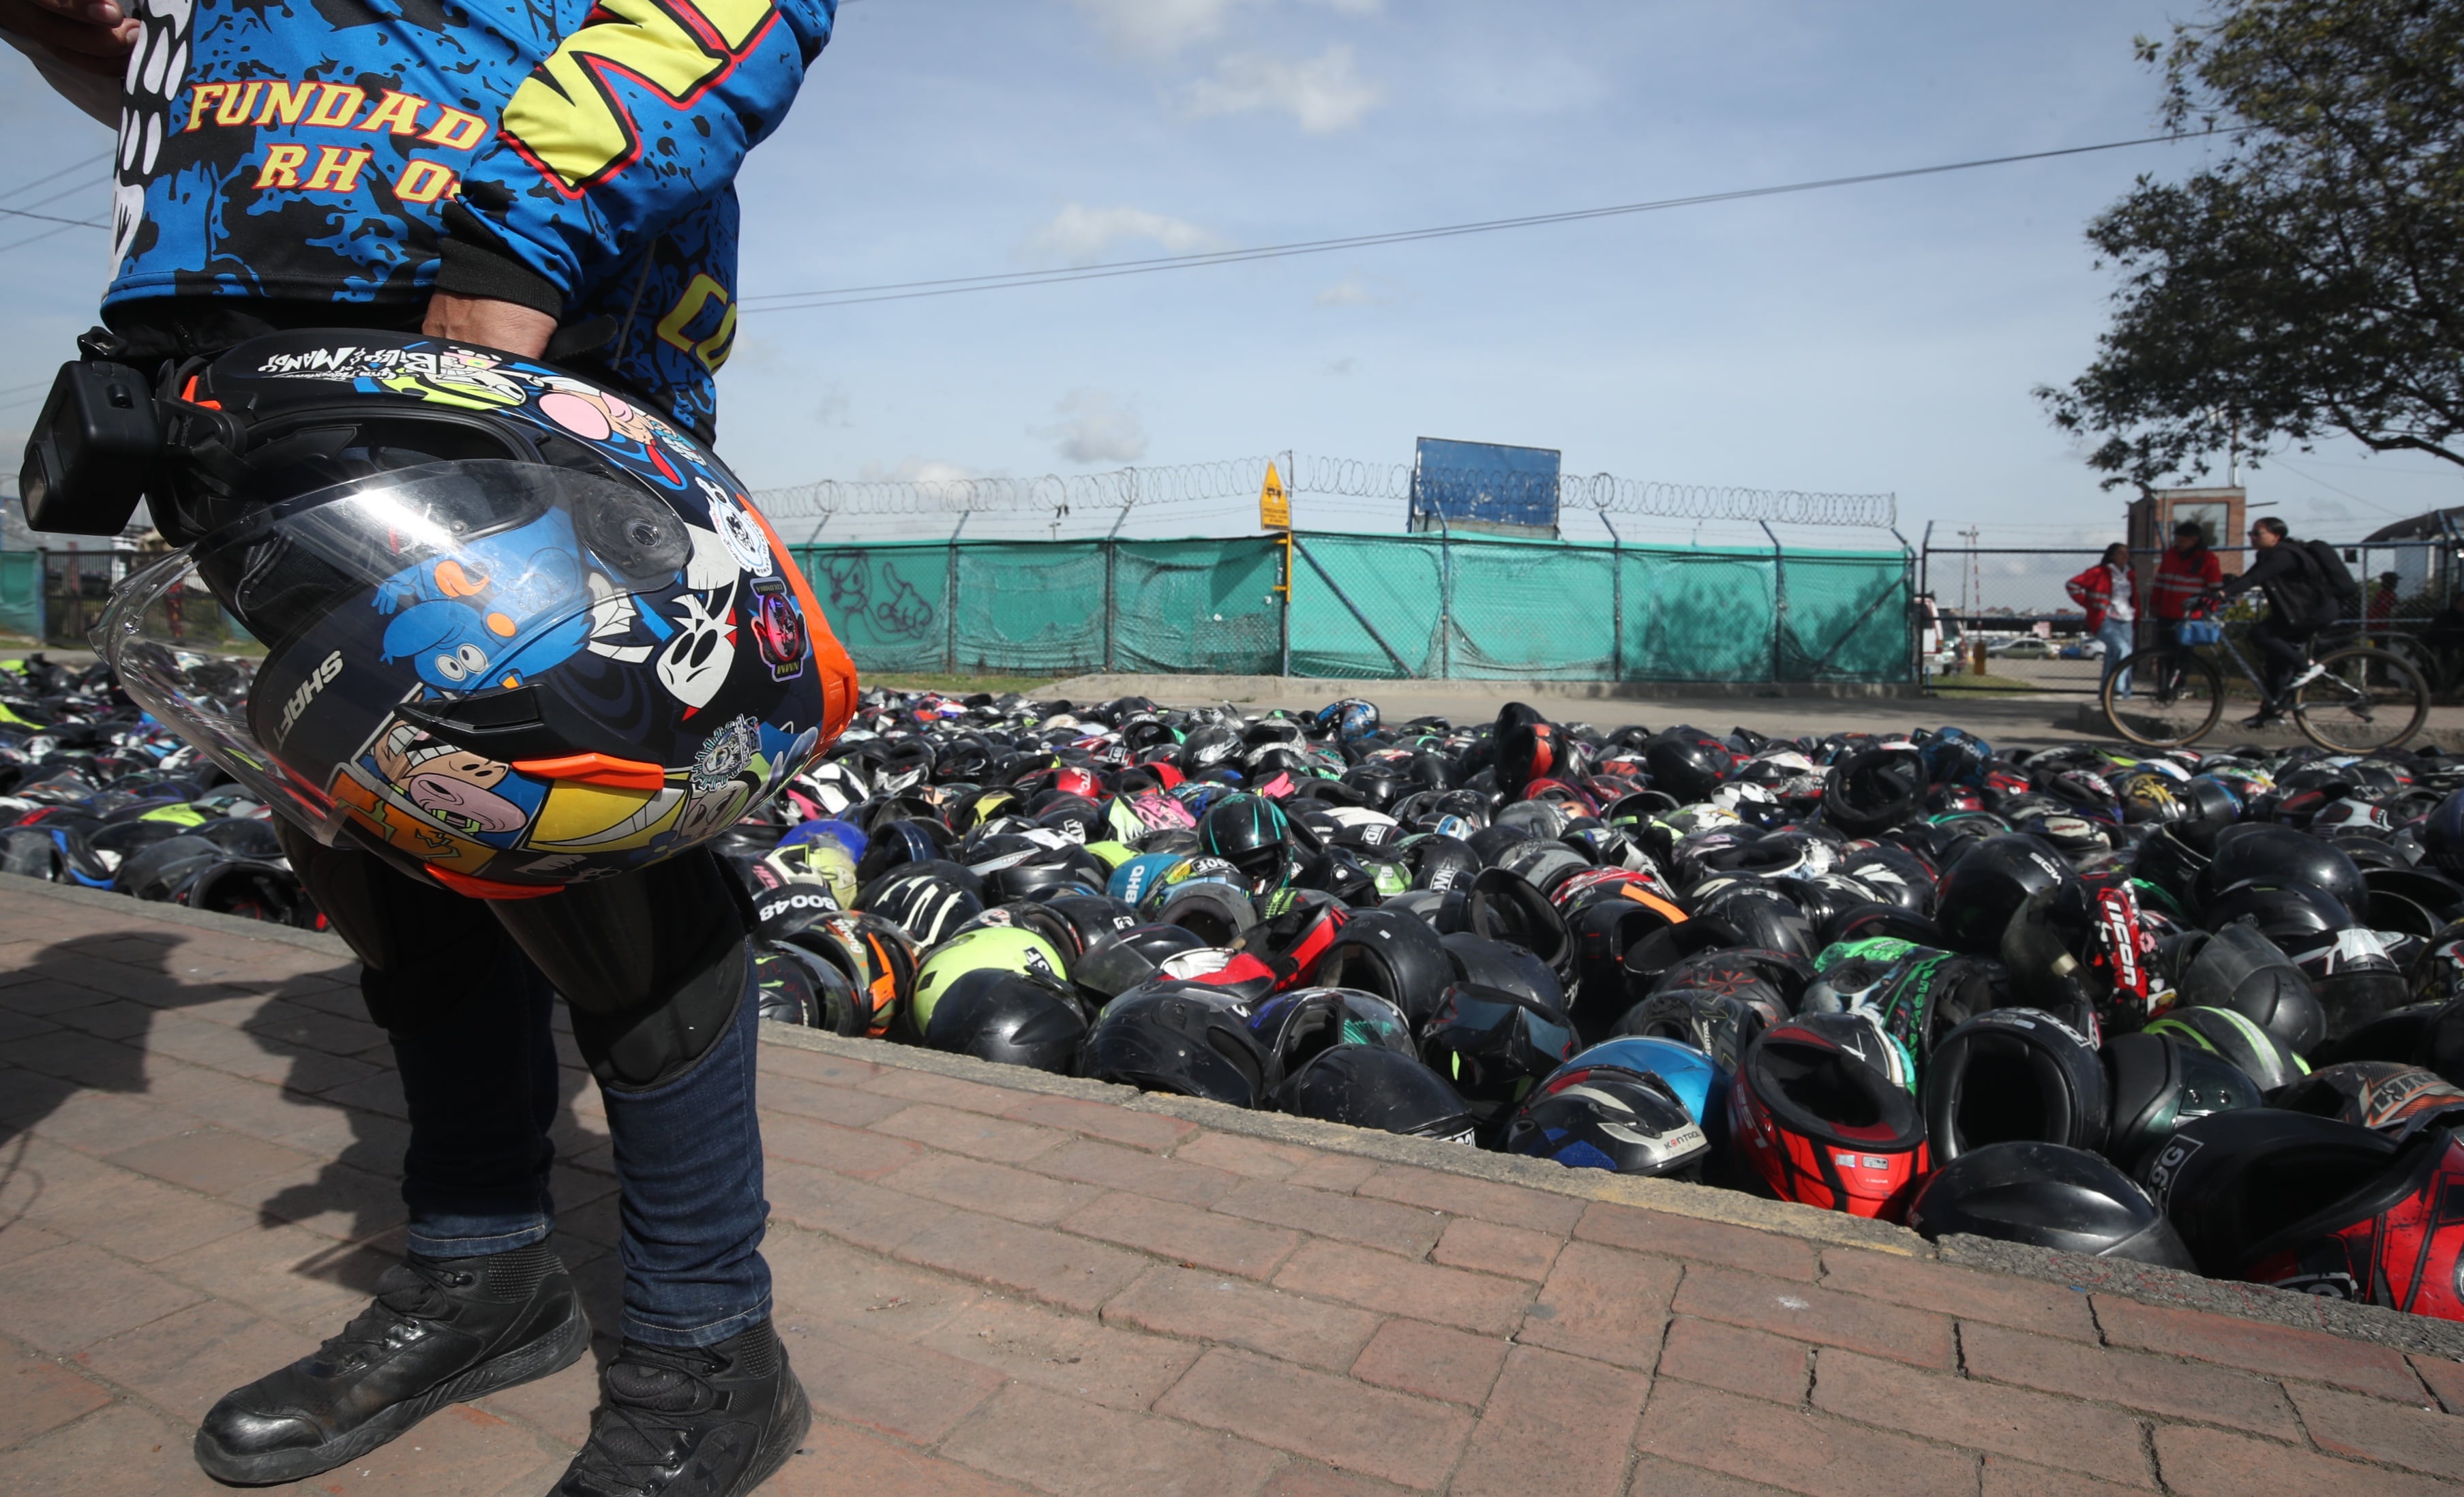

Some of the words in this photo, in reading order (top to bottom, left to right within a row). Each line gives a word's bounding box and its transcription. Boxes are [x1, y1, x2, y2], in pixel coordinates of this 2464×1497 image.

[183, 80, 490, 151] FUNDAD
[252, 143, 374, 193] RH
[776, 661, 800, 676] NMM
[273, 650, 344, 751] SHAFT
[1125, 864, 1145, 904] QHB
